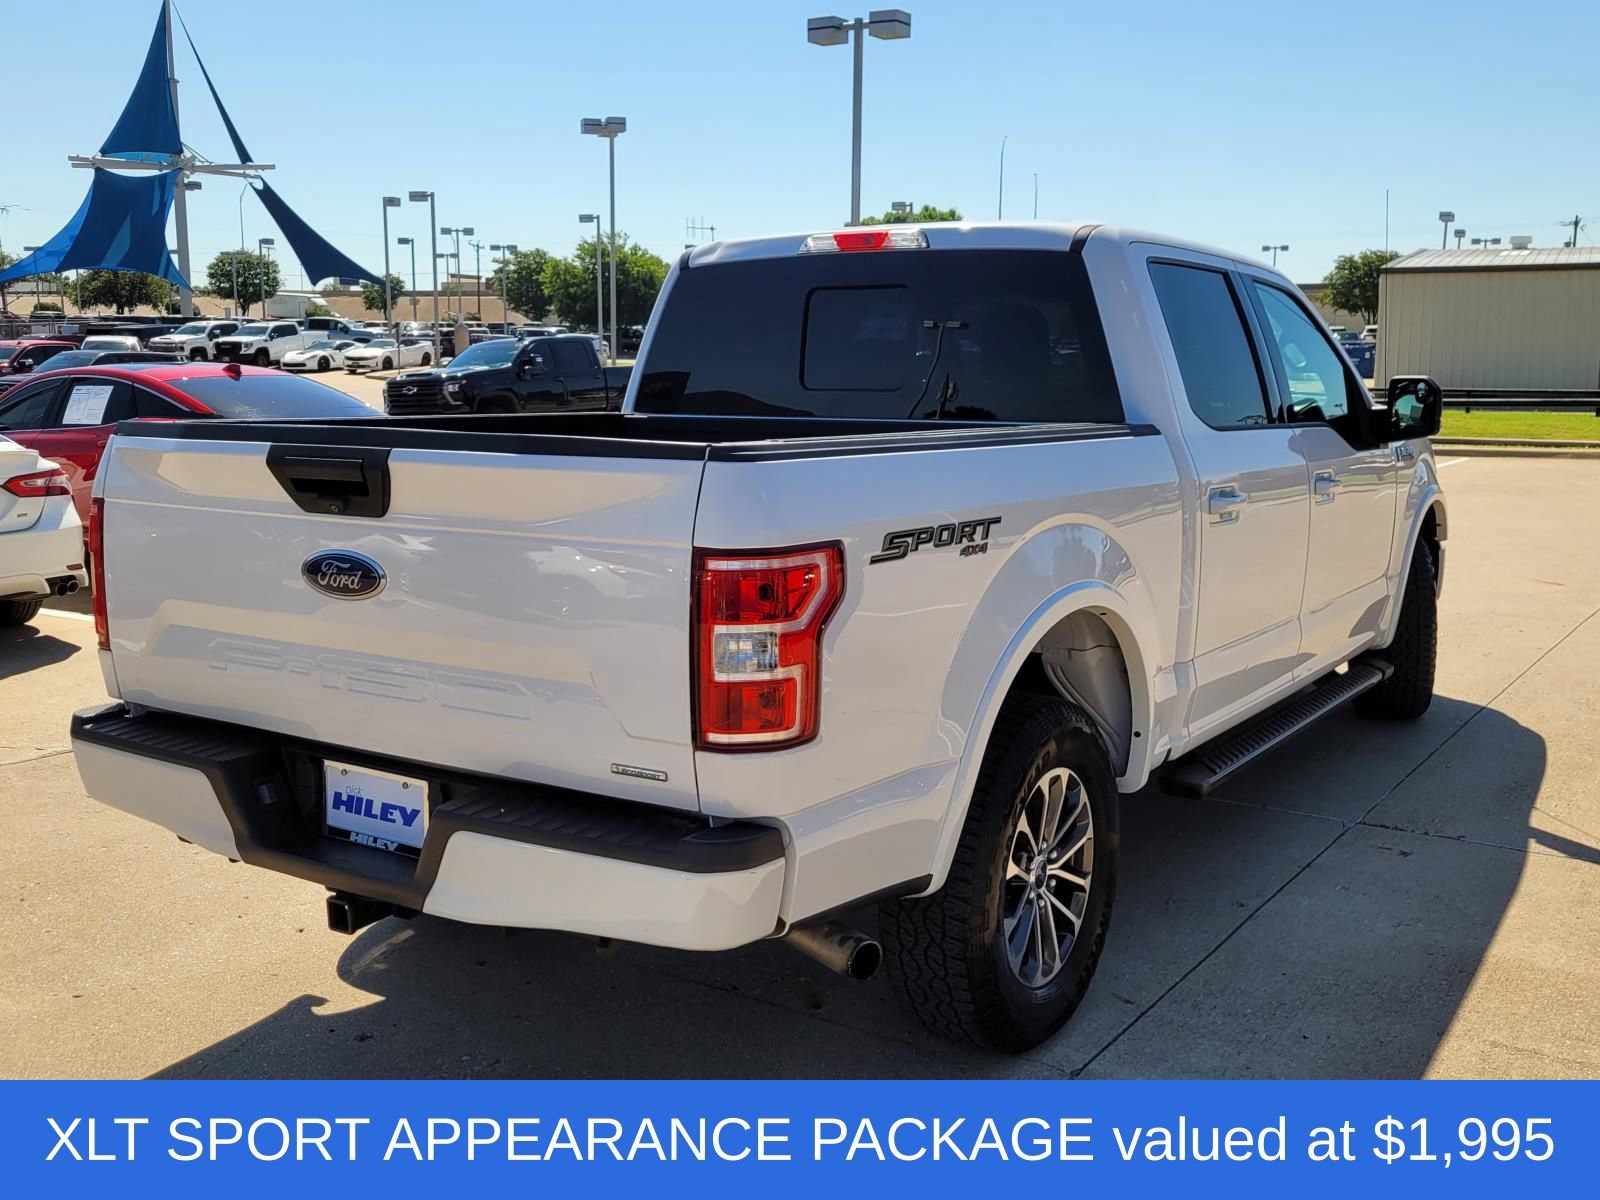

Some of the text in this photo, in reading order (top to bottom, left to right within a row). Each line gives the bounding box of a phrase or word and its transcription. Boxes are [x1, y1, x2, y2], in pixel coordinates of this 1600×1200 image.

[869, 516, 1002, 566] SPORT
[317, 559, 364, 590] Ford
[331, 791, 421, 828] HILEY
[349, 831, 399, 852] HILEY
